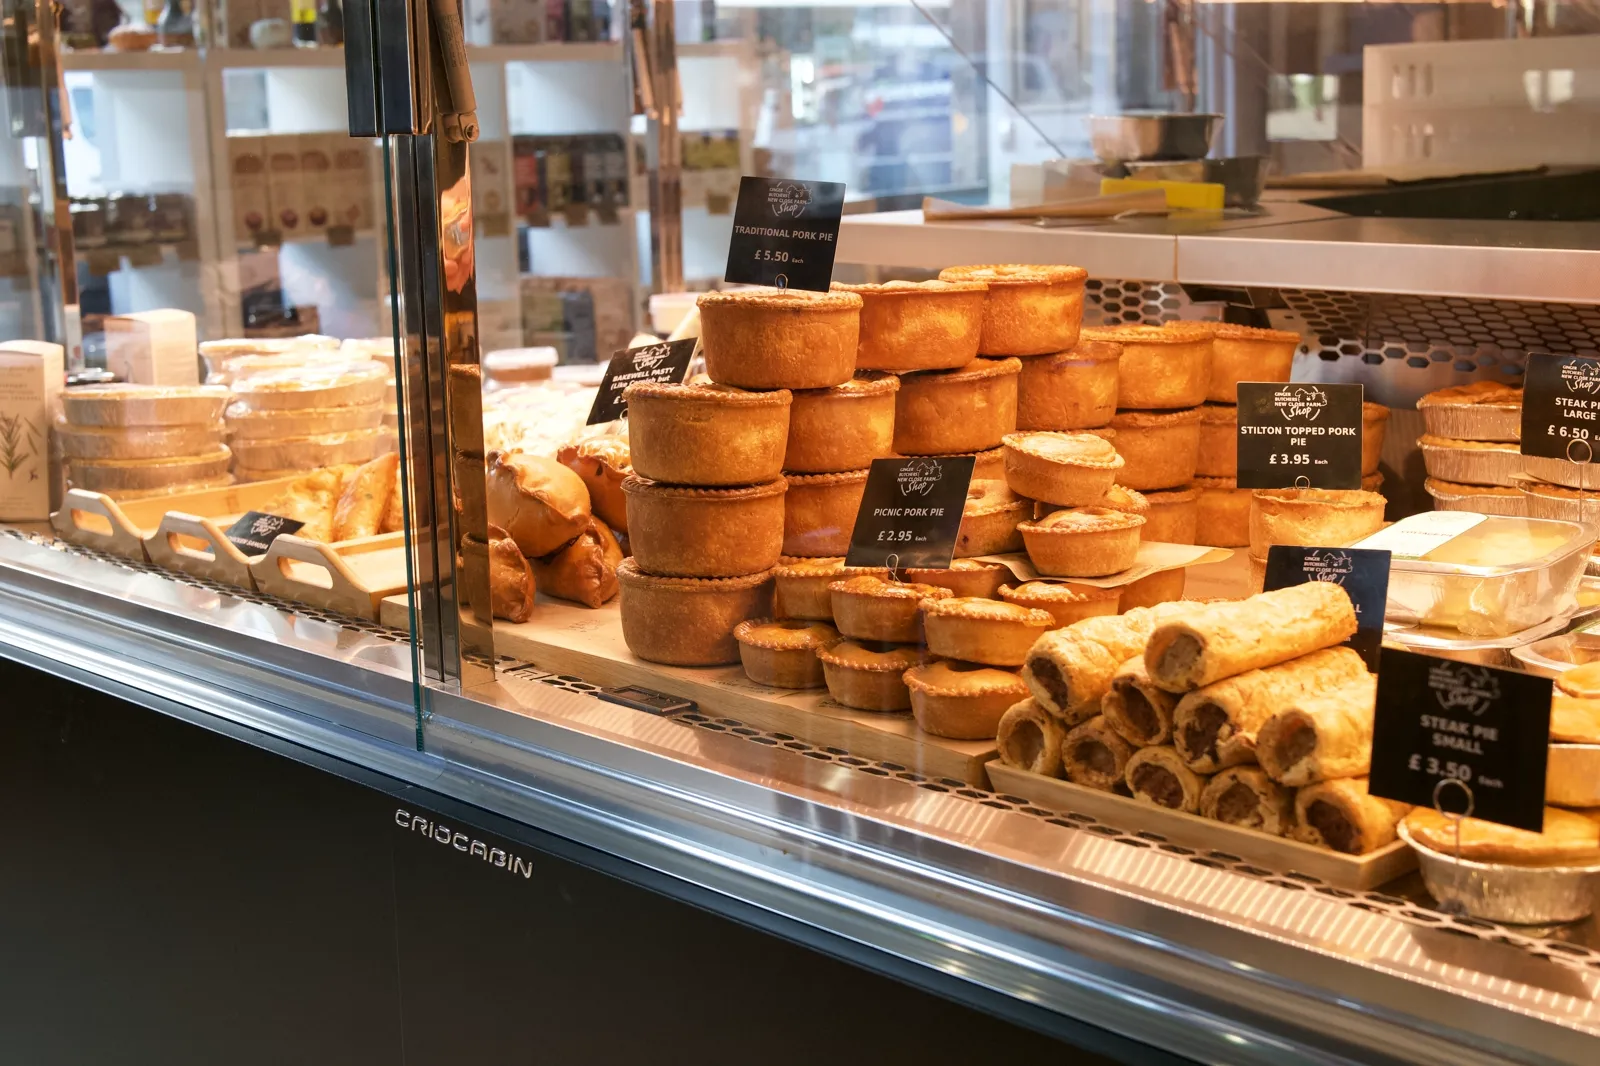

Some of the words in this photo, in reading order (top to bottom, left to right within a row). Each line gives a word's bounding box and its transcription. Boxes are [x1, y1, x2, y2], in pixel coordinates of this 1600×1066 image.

[777, 202, 798, 216] Shop
[735, 225, 790, 238] TRADITIONAL
[792, 230, 817, 240] PORK
[819, 232, 834, 241] PIE
[754, 249, 762, 260] £
[763, 250, 789, 262] 5.50
[612, 371, 650, 382] BAKEWELL
[651, 367, 675, 376] PASTY
[1573, 380, 1594, 392] Shop
[1555, 397, 1588, 409] STEAK
[1590, 402, 1600, 410] PI
[1288, 405, 1312, 419] Shop
[1563, 409, 1597, 421] LARGE
[1241, 426, 1282, 435] STILTON
[1285, 426, 1326, 435] TOPPED
[1328, 427, 1357, 436] PORK
[1547, 424, 1556, 436] £
[1559, 426, 1589, 440] 6.50
[1290, 438, 1307, 446] PIE
[1269, 453, 1278, 465] £
[1280, 453, 1310, 465] 3.95
[906, 481, 927, 494] Shop
[873, 508, 902, 517] PICNIC
[904, 508, 928, 517] PORK
[930, 508, 944, 517] PIE
[877, 530, 885, 541] £
[887, 530, 912, 541] 2.95
[1420, 714, 1470, 736] STEAK
[1473, 724, 1499, 741] PIE
[1432, 732, 1485, 755] SMALL
[1408, 753, 1422, 771] £
[1426, 757, 1472, 782] 3.50
[394, 808, 533, 879] CRIOCABIN
